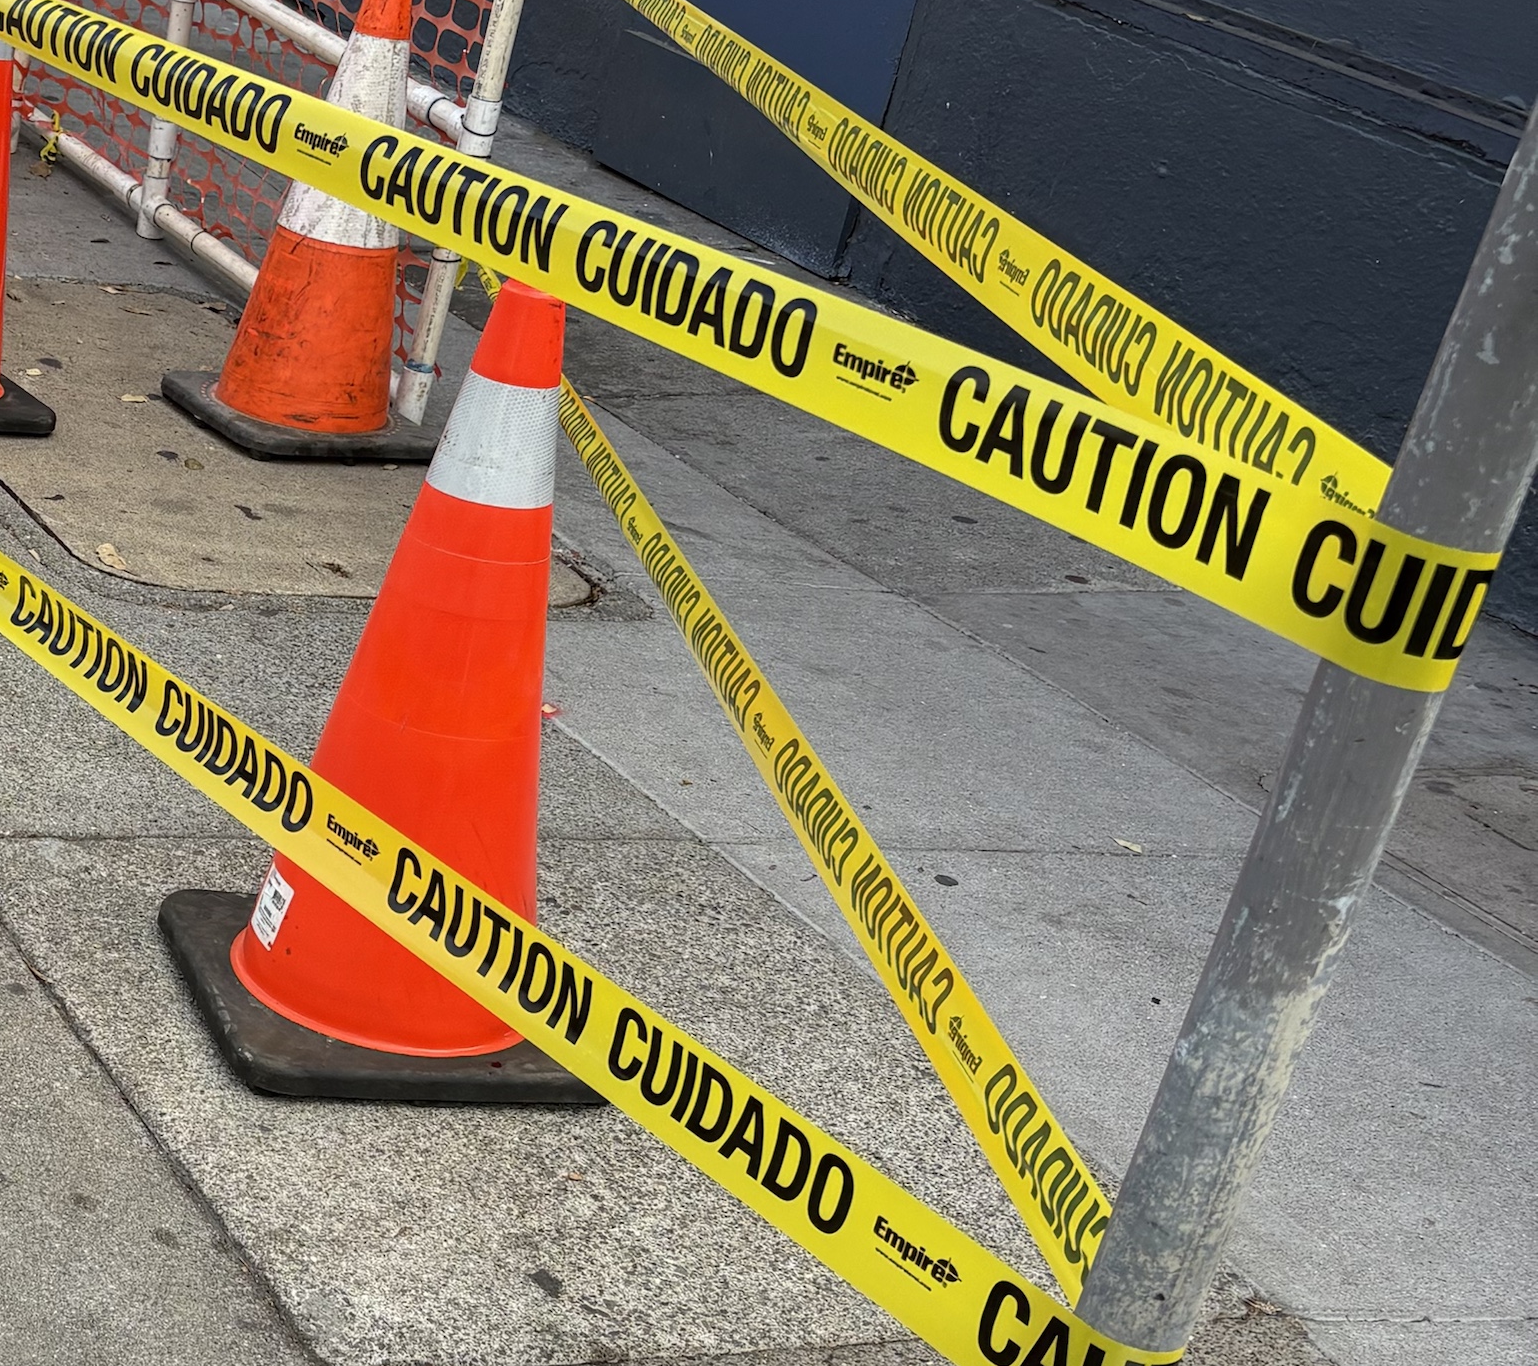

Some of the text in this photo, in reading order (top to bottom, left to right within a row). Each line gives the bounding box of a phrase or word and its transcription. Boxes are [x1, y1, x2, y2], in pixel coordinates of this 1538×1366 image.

[130, 43, 292, 154] CUIDADO
[294, 122, 342, 156] Empire
[359, 133, 570, 275] CAUTION
[575, 219, 818, 380] CUIDADO
[833, 342, 910, 391] Empire
[937, 364, 1272, 582] CAUTION
[10, 574, 150, 714] CAUTION
[154, 679, 314, 833] CUIDADO
[327, 813, 376, 860] Empire
[387, 847, 593, 1045] CAUTION
[608, 1007, 854, 1234] CUIDADO
[873, 1215, 950, 1284] Empire
